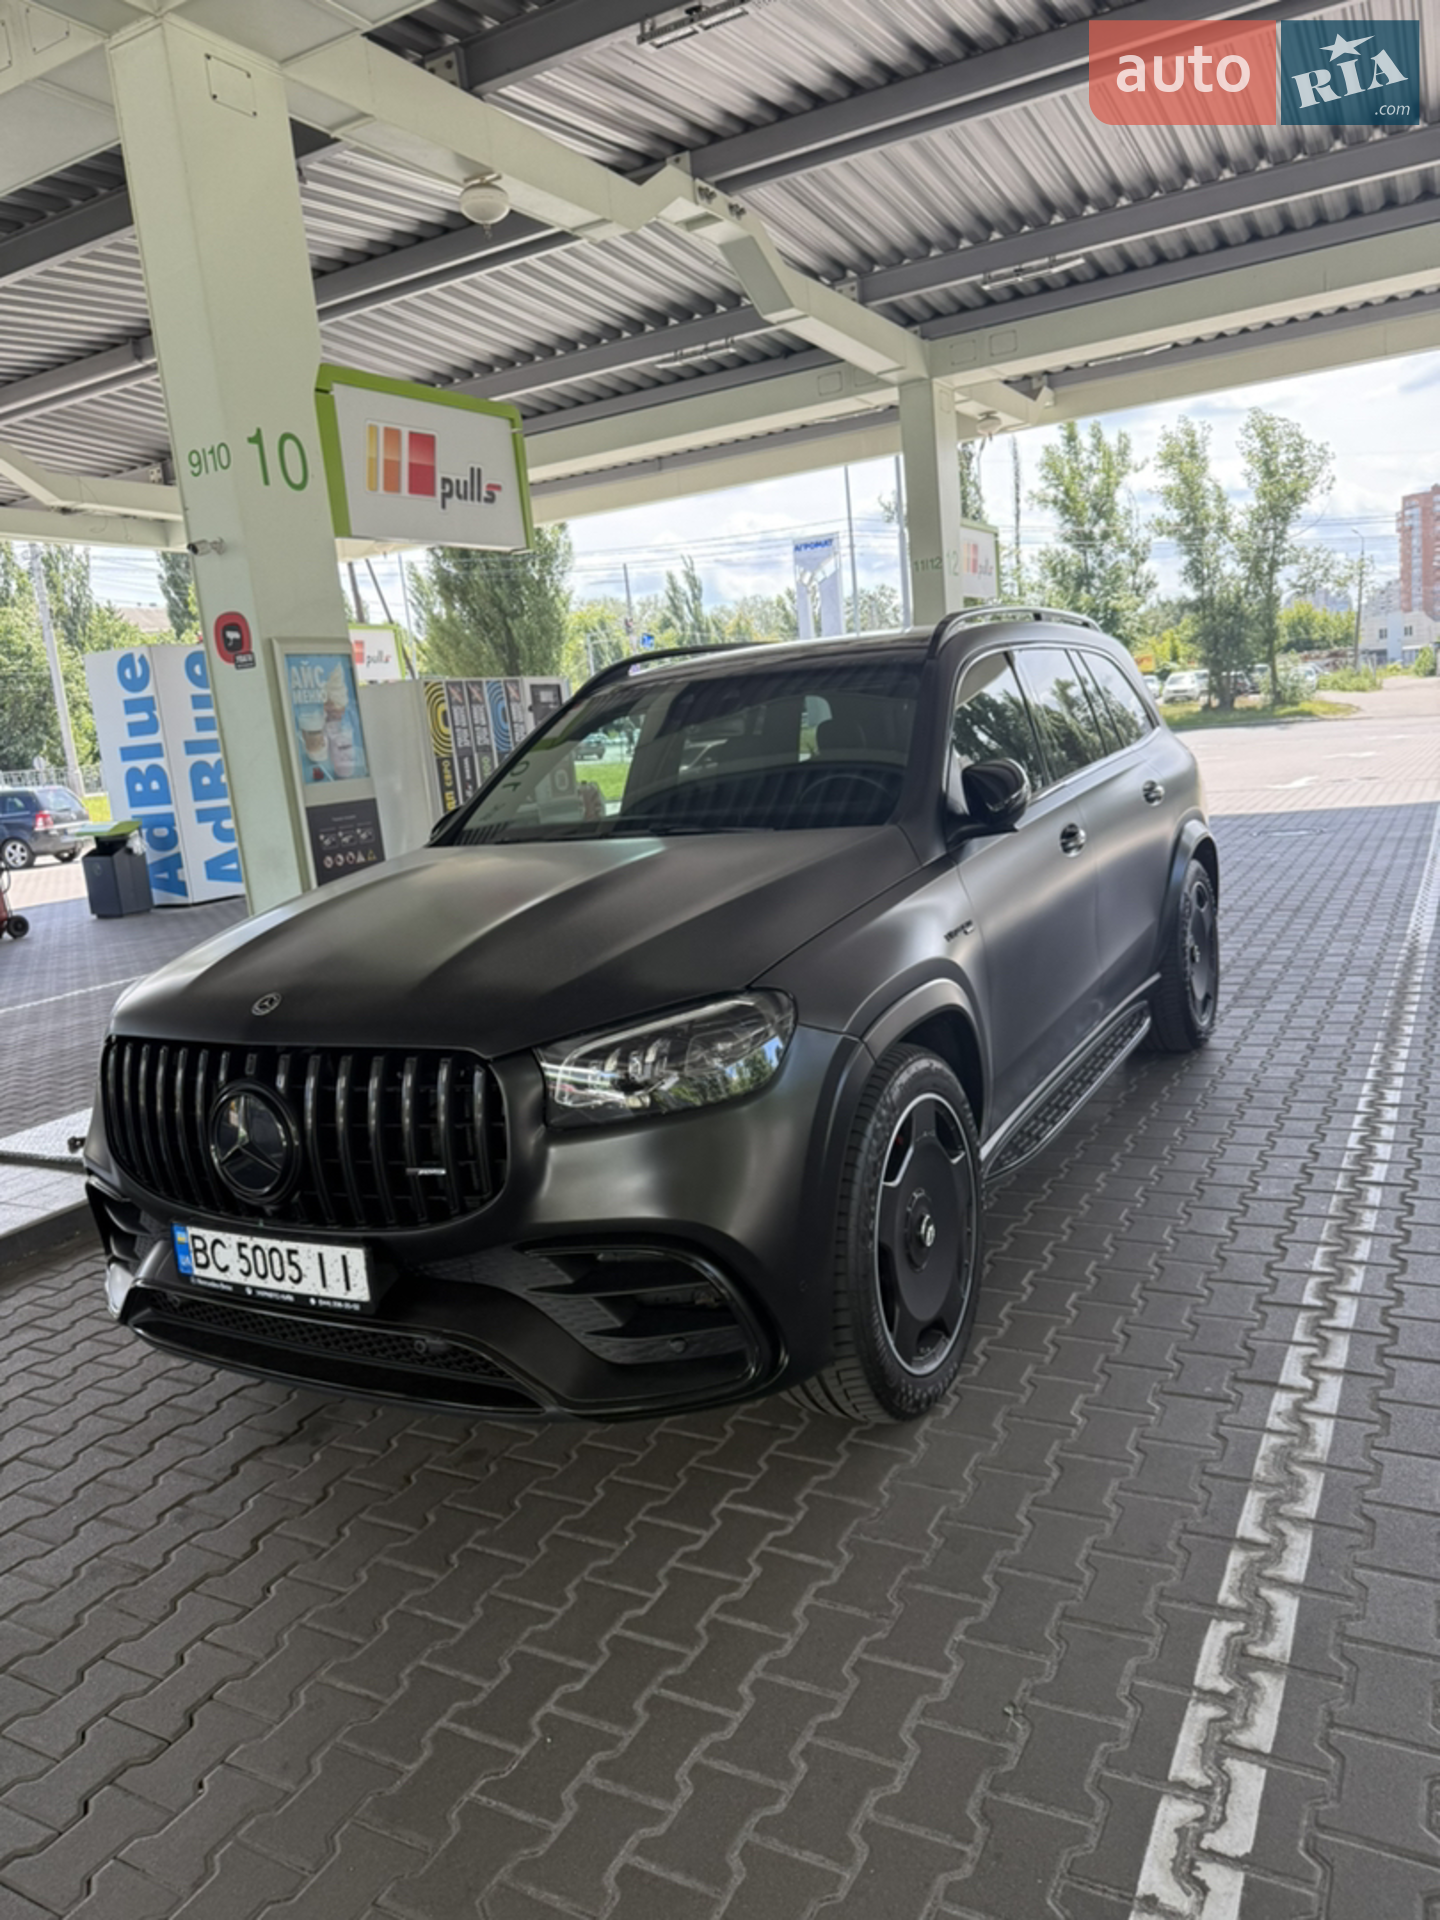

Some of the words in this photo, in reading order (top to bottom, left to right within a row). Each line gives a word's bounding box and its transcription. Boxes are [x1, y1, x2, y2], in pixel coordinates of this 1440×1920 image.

[247, 427, 309, 492] 10
[440, 466, 503, 510] pulls
[116, 652, 189, 898] AdBlue
[190, 1234, 230, 1273] BC
[236, 1241, 304, 1285] 5005
